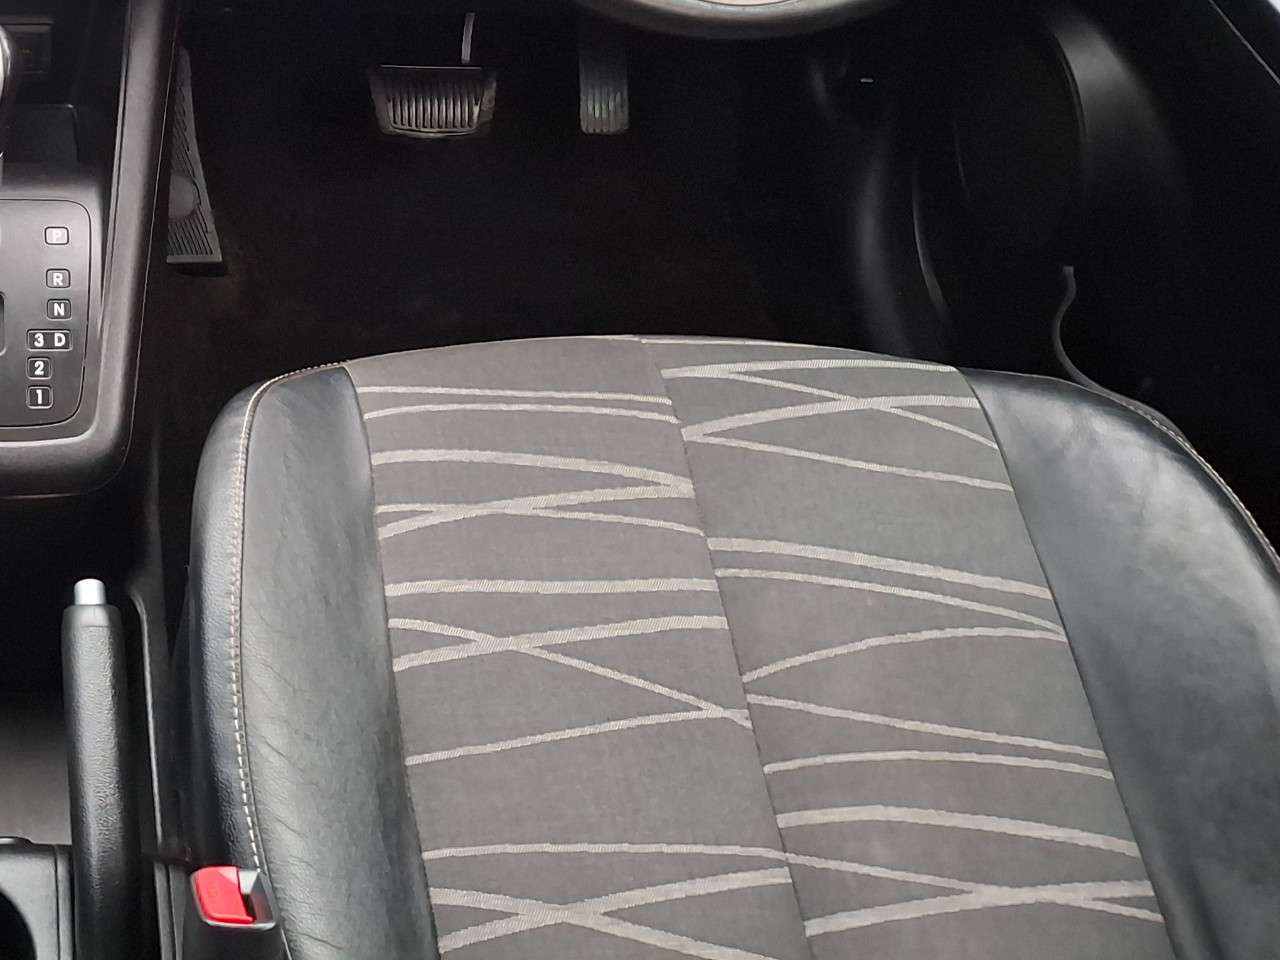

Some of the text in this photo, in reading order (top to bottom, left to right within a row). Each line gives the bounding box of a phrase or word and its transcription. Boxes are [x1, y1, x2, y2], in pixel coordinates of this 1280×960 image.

[52, 272, 64, 286] R
[53, 302, 66, 316] N
[34, 333, 66, 347] 3 D
[33, 361, 45, 376] 2
[35, 389, 44, 404] 1
